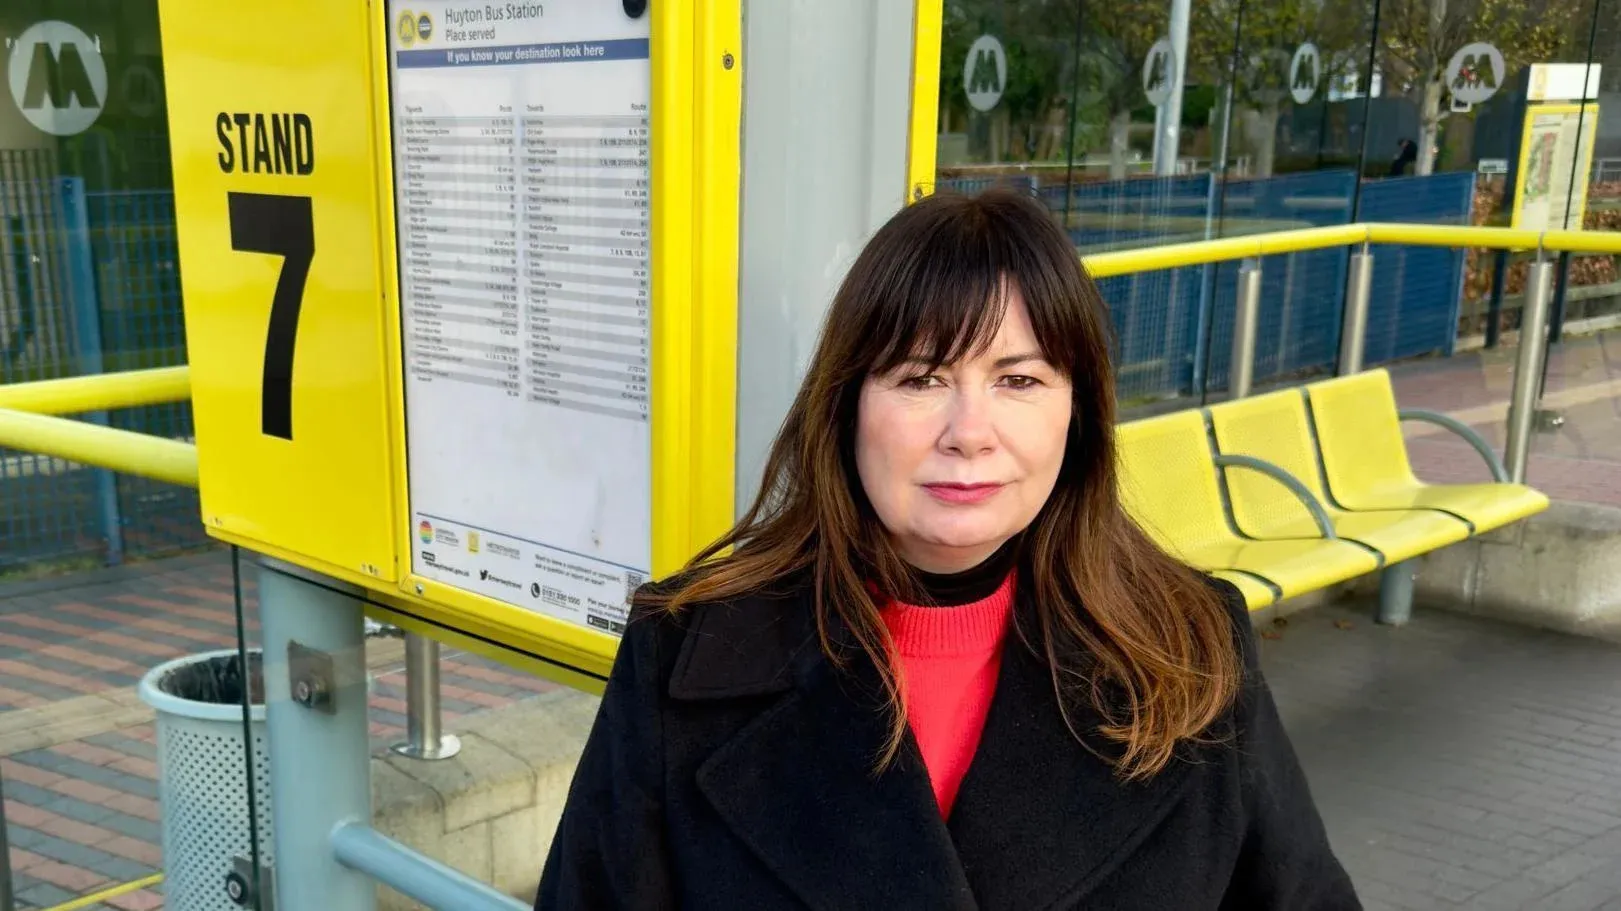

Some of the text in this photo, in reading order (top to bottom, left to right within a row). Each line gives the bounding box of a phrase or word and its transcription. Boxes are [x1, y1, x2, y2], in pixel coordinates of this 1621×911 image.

[445, 3, 543, 26] Huyton Bus Station
[445, 28, 495, 42] Place served
[447, 44, 605, 64] If you know your destination look here
[216, 112, 314, 176] STAND
[227, 191, 316, 441] 7
